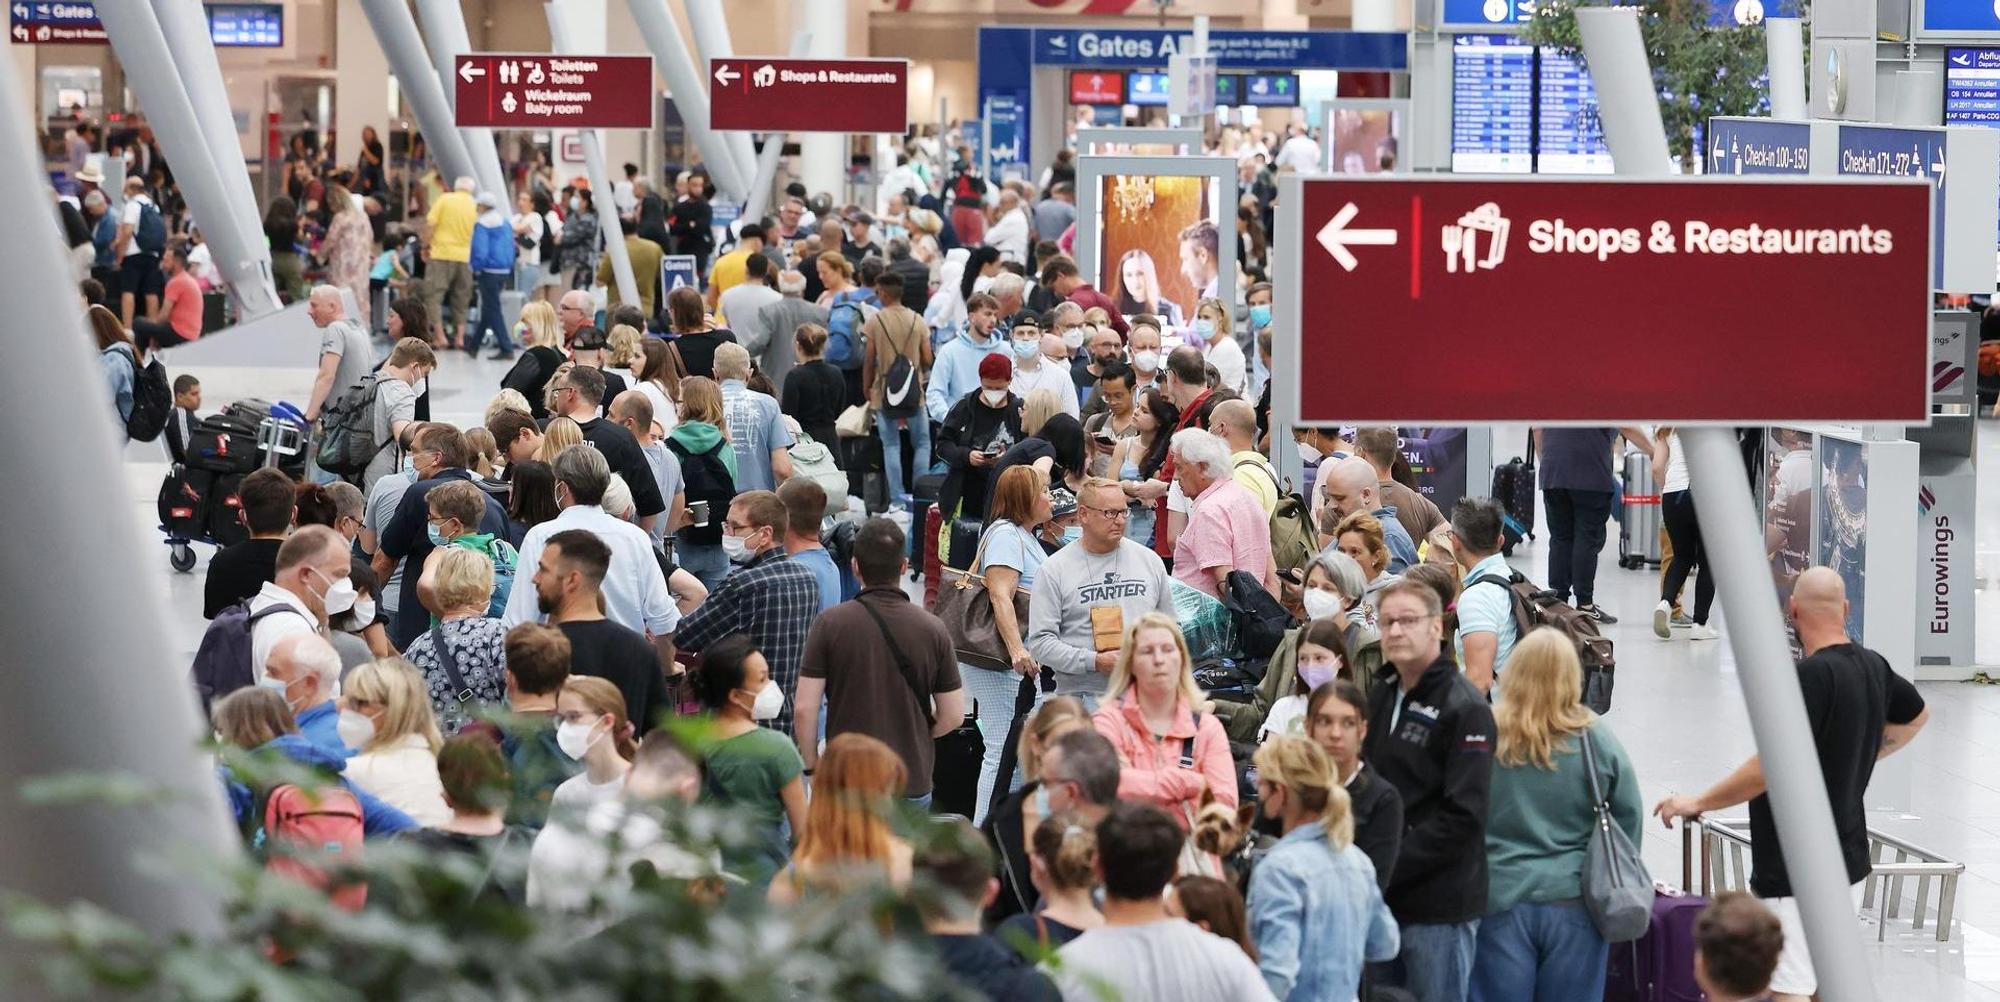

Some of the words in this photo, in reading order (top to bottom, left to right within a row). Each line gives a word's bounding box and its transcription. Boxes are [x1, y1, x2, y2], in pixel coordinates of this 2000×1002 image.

[1077, 33, 1153, 58] Gates
[1158, 35, 1178, 58] A
[549, 59, 599, 72] Toiletten
[549, 72, 585, 85] Toilets
[780, 69, 817, 84] Shops
[818, 69, 828, 83] &
[829, 70, 897, 84] Restaurants
[525, 89, 592, 102] Wickelraum
[525, 102, 554, 116] Baby
[554, 105, 583, 115] room
[1744, 144, 1775, 168] Check-in
[1843, 150, 1876, 174] Check-in
[1528, 218, 1642, 262] Shops
[1648, 221, 1678, 255] &
[1685, 220, 1894, 255] Restaurants
[1930, 515, 1954, 634] Eurowings
[1080, 583, 1146, 604] STARTER
